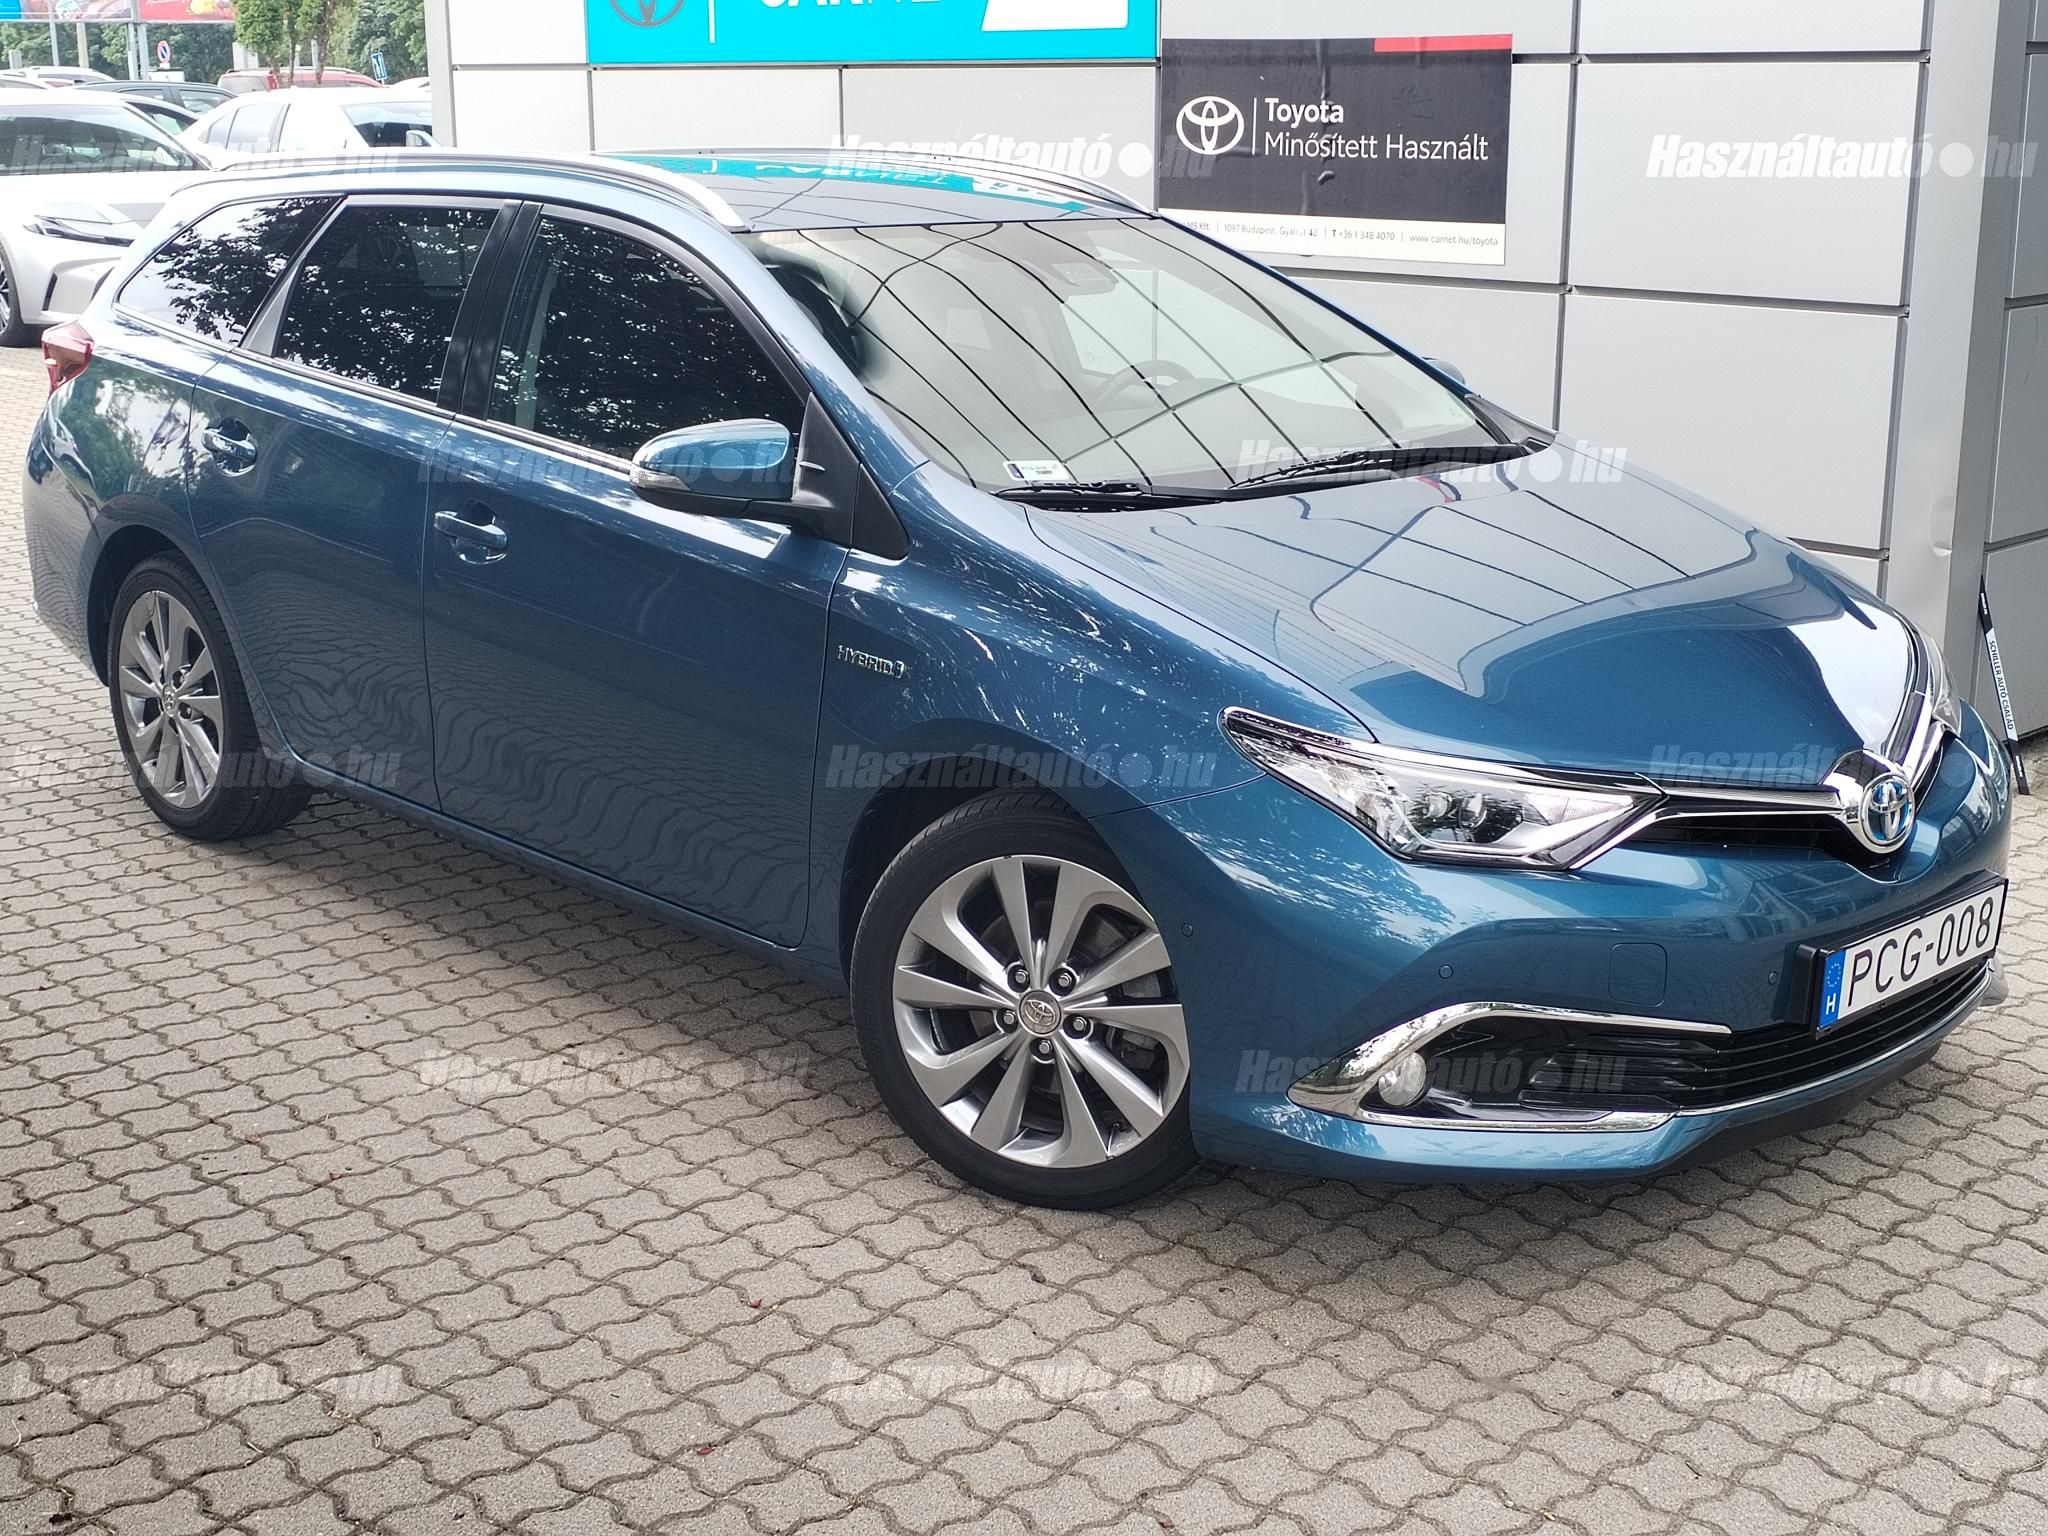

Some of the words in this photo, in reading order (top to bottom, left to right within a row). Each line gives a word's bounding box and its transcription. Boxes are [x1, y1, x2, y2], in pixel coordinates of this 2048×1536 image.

[1265, 98, 1344, 127] Toyota
[1265, 131, 1378, 158] Minősített
[1386, 134, 1489, 160] Használt
[1224, 224, 1239, 232] 1097
[1331, 229, 1337, 238] T
[1409, 233, 1498, 248] wwwcarnethu/toyota
[837, 645, 895, 676] HYBRID
[1989, 640, 2001, 676] SCHILLER
[1847, 896, 1994, 1008] PCG-008
[1826, 993, 1837, 1015] H
